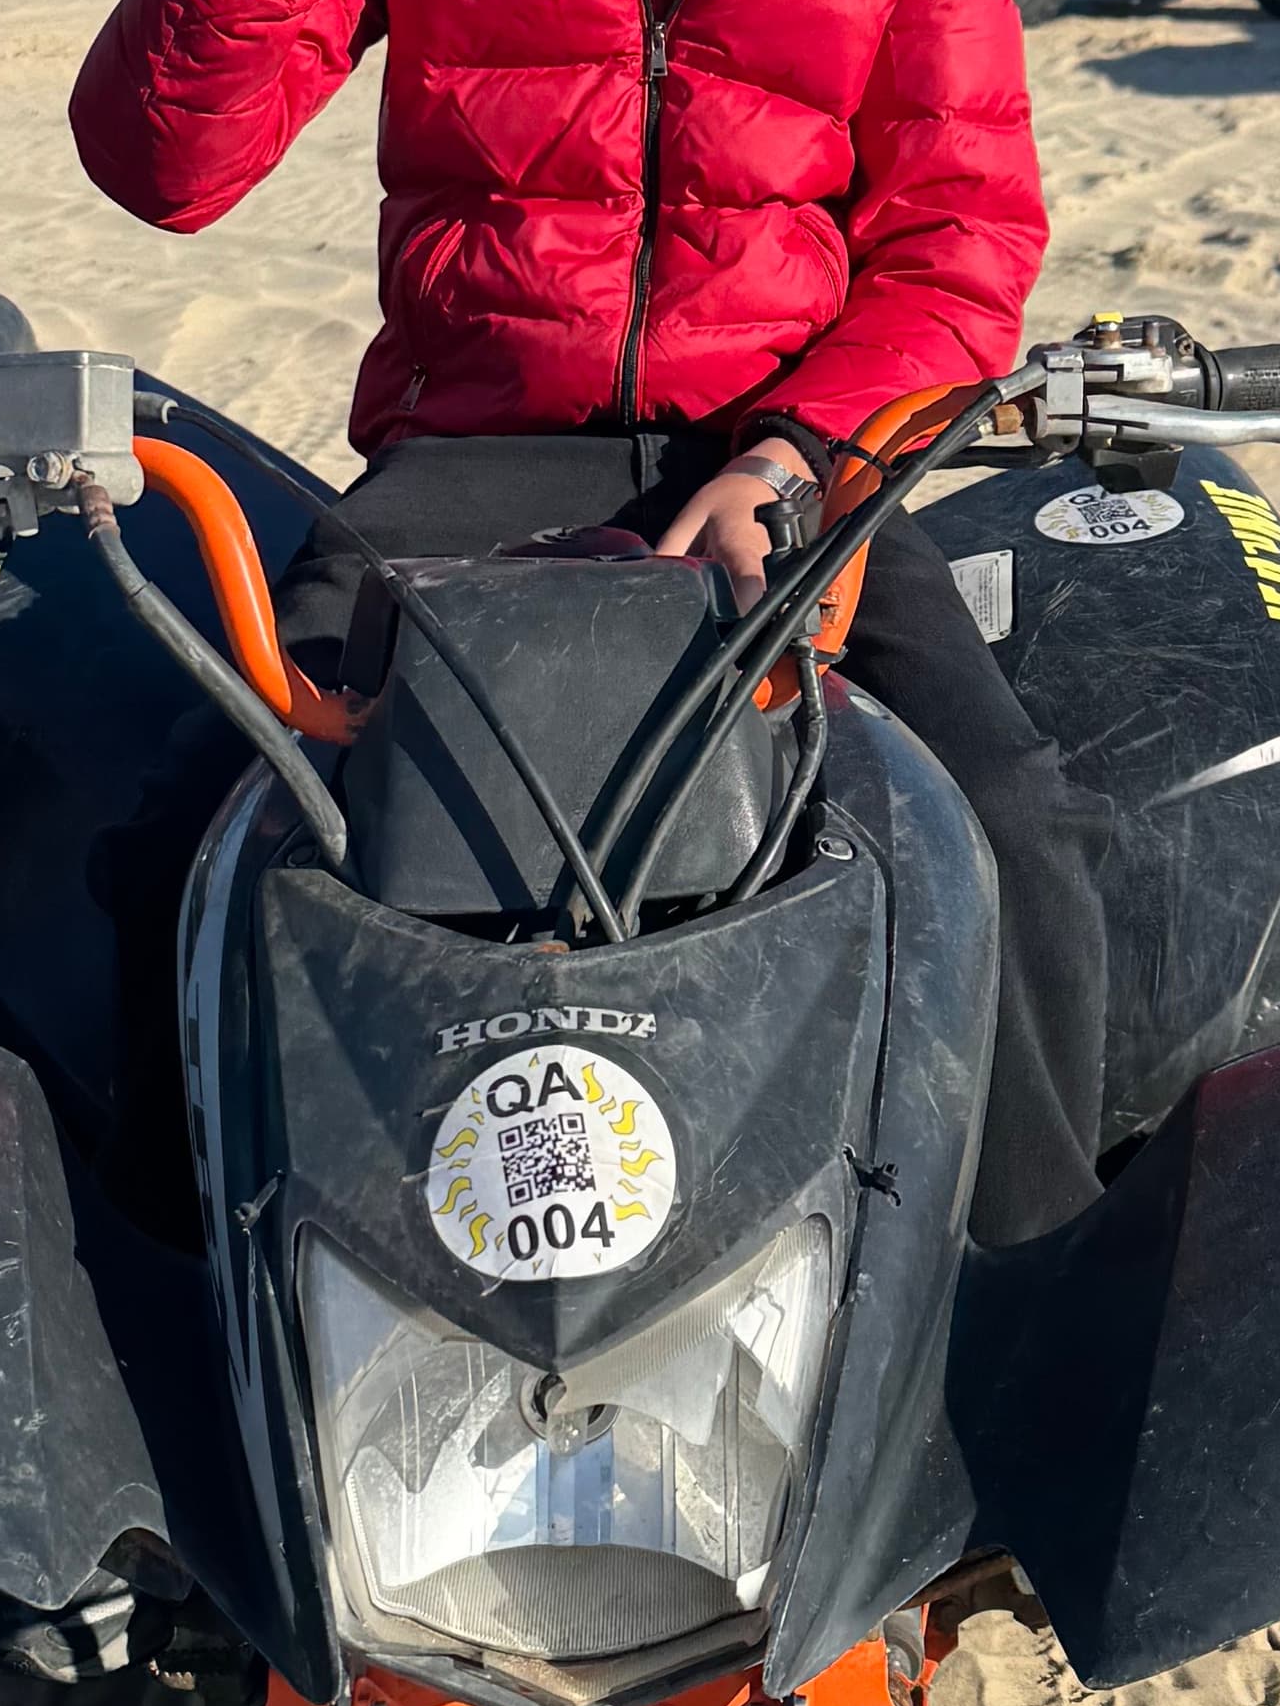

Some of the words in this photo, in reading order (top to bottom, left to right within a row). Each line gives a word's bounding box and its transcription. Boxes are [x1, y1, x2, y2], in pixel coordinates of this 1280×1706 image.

[1089, 519, 1153, 538] 004
[436, 1006, 657, 1055] HONDA
[486, 1062, 584, 1118] QA
[507, 1202, 616, 1261] 004
